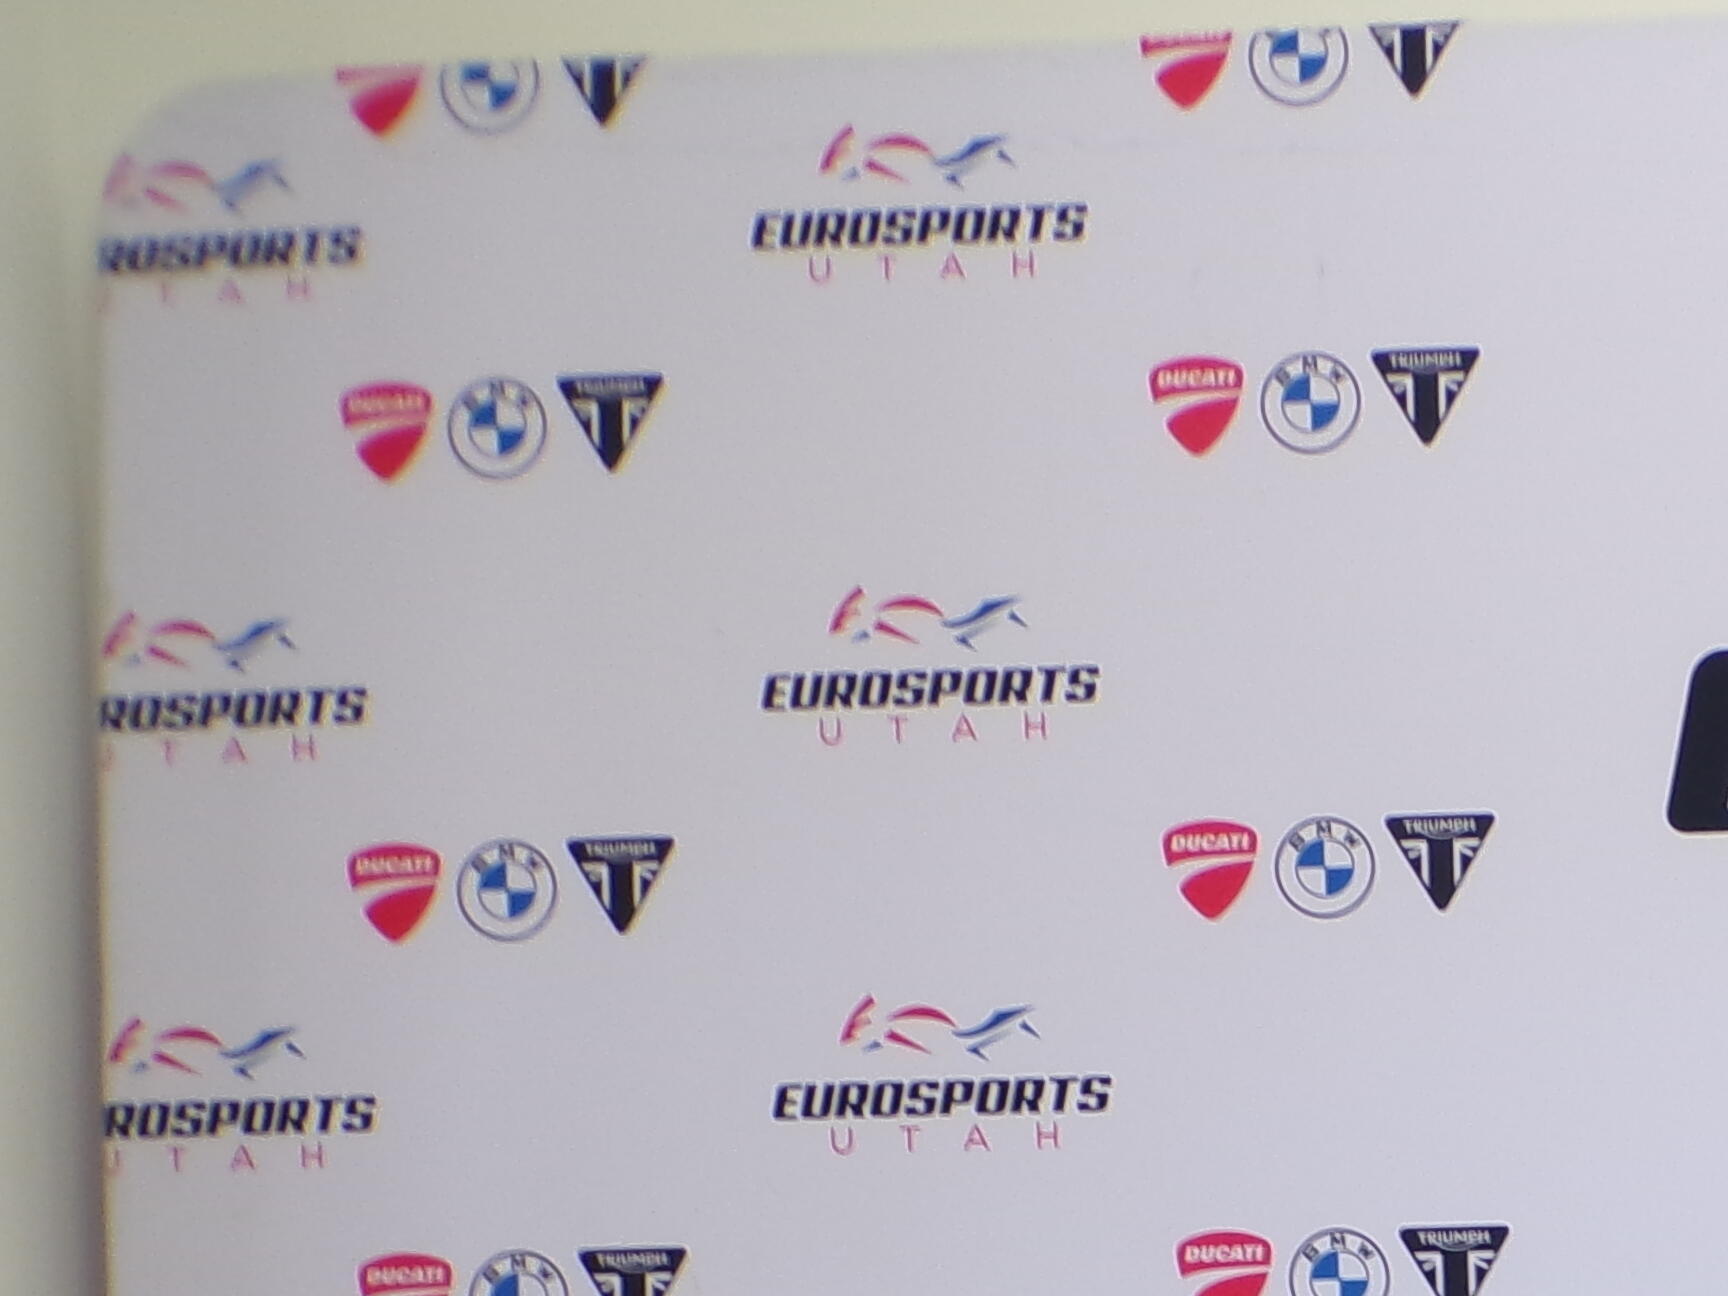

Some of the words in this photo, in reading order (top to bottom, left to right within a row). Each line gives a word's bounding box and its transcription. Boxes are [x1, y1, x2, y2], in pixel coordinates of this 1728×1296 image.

[752, 203, 1088, 251] EUROSPORTS
[808, 253, 1038, 285] UTAH
[1156, 367, 1235, 389] DUCATI
[761, 665, 1100, 711] EUROSPORTS
[818, 713, 1050, 747] UTAH
[1402, 816, 1477, 834] TRIUMPH
[1170, 831, 1250, 852] DUCATI
[773, 1075, 1112, 1121] EUROSPORTS
[830, 1123, 1062, 1156] UTAH
[1416, 1229, 1491, 1246] TRIUMPH
[1184, 1242, 1264, 1264] DUCATI
[367, 1266, 443, 1285] DUCATI
